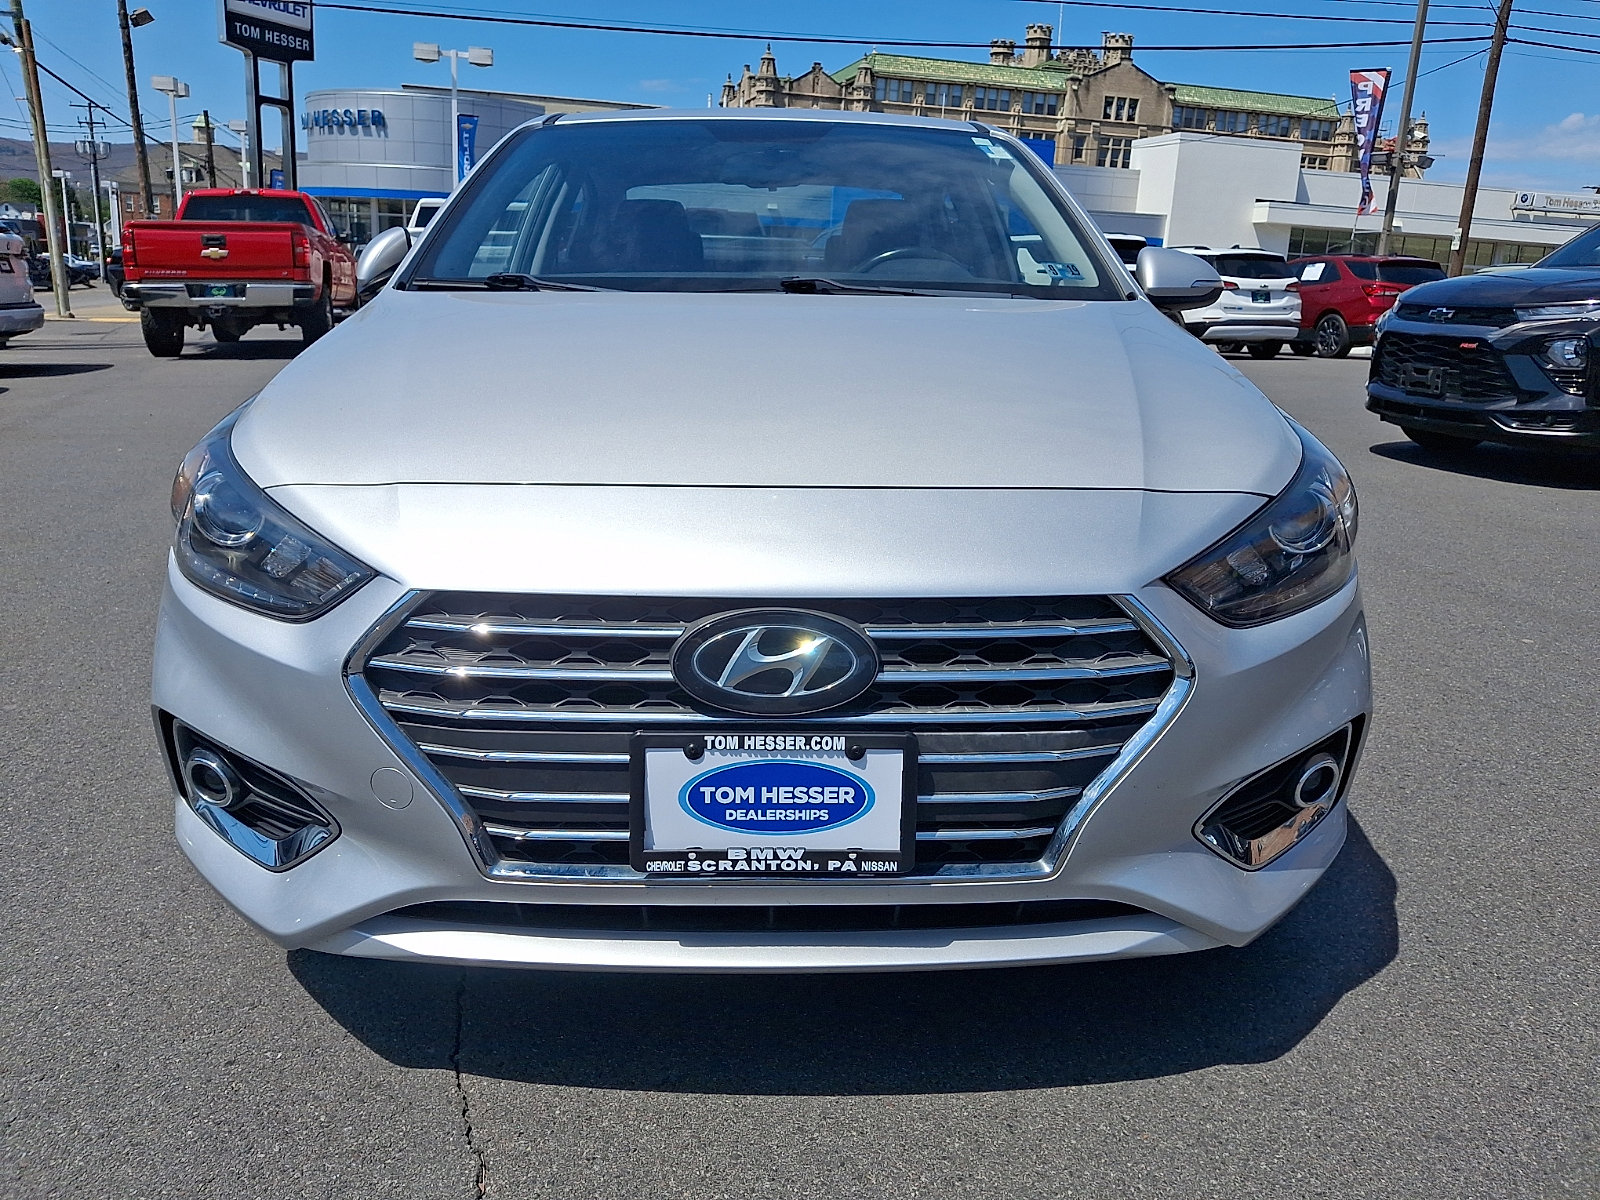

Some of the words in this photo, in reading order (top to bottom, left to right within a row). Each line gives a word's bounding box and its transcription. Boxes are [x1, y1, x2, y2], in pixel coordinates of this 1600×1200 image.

[234, 22, 260, 39] TOM
[265, 30, 310, 51] HESSER
[704, 736, 739, 750] TOM
[744, 736, 846, 751] HESSER.COM
[700, 786, 755, 804] TOM
[761, 786, 855, 804] HESSER
[725, 809, 829, 821] DEALERSHIPS
[727, 847, 806, 860] BMW
[646, 861, 685, 872] CHEVROLET
[687, 860, 819, 871] SCRANTON,
[827, 861, 858, 872] PA
[861, 861, 898, 872] NISSAN
